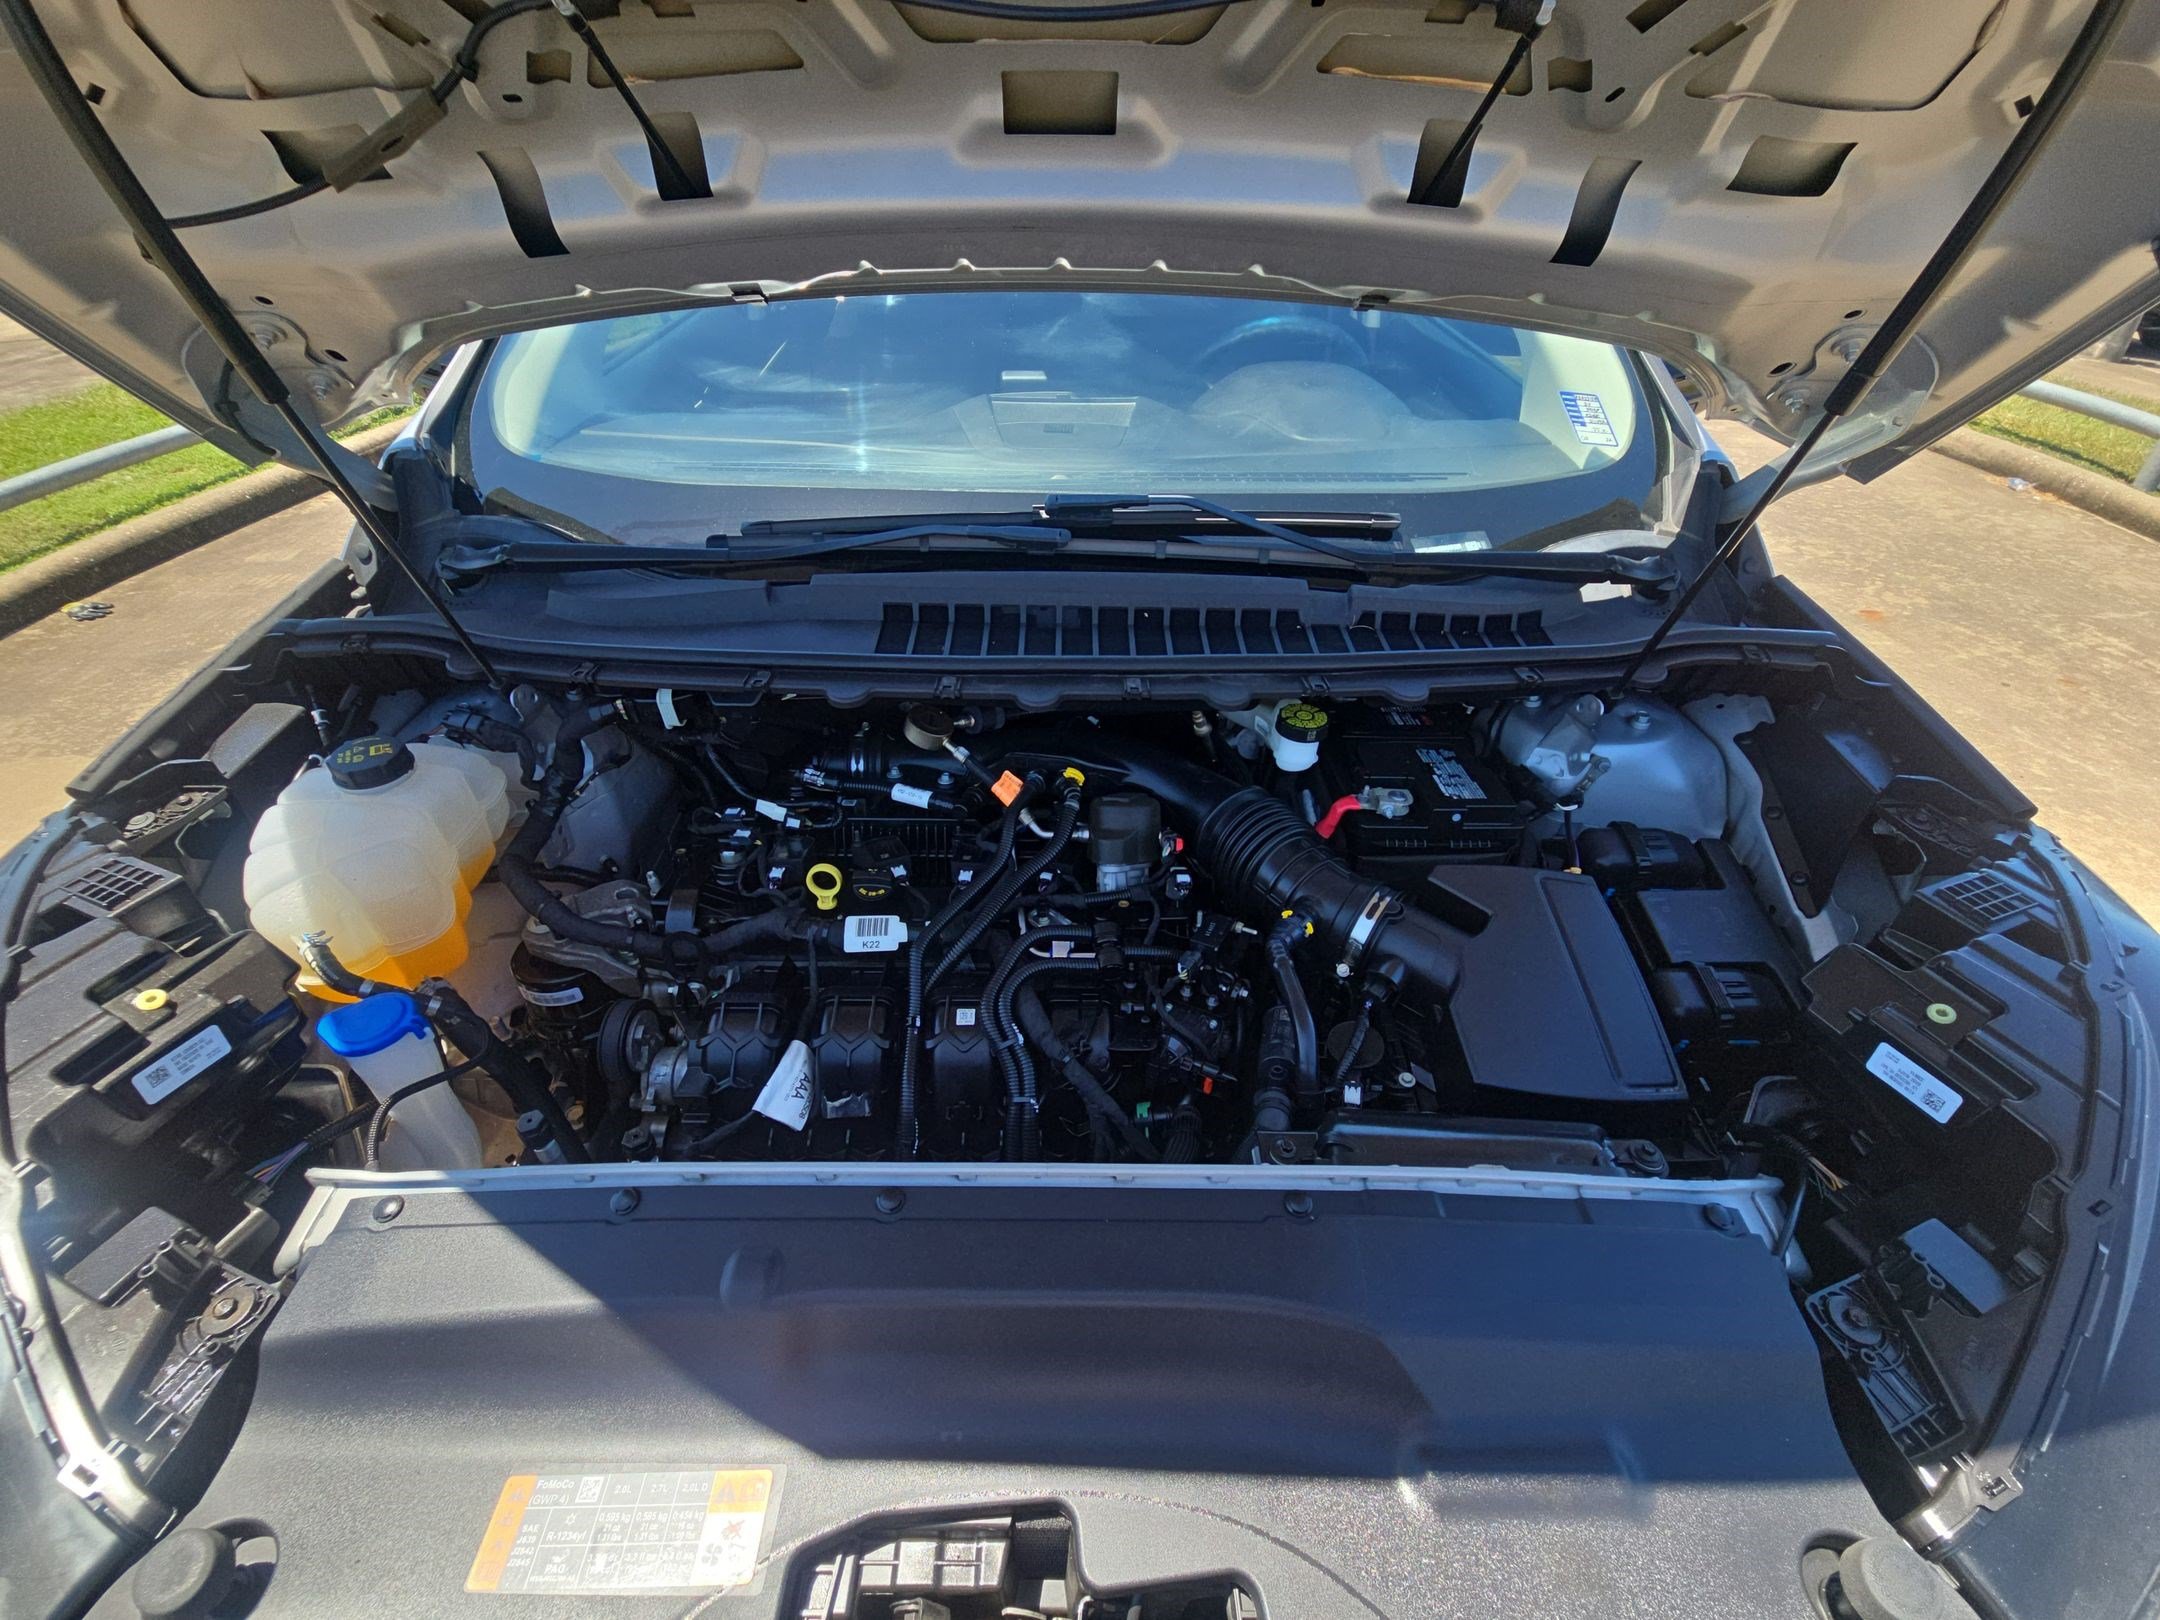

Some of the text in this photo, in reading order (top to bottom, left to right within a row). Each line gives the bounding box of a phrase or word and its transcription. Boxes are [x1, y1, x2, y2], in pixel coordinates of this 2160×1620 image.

[862, 941, 880, 949] K22
[791, 1072, 811, 1100] AAA
[536, 1479, 575, 1489] FoMoCo
[528, 1494, 570, 1505] (GWP 4)
[522, 1524, 541, 1533] SAE
[545, 1530, 588, 1543] R-1234yf
